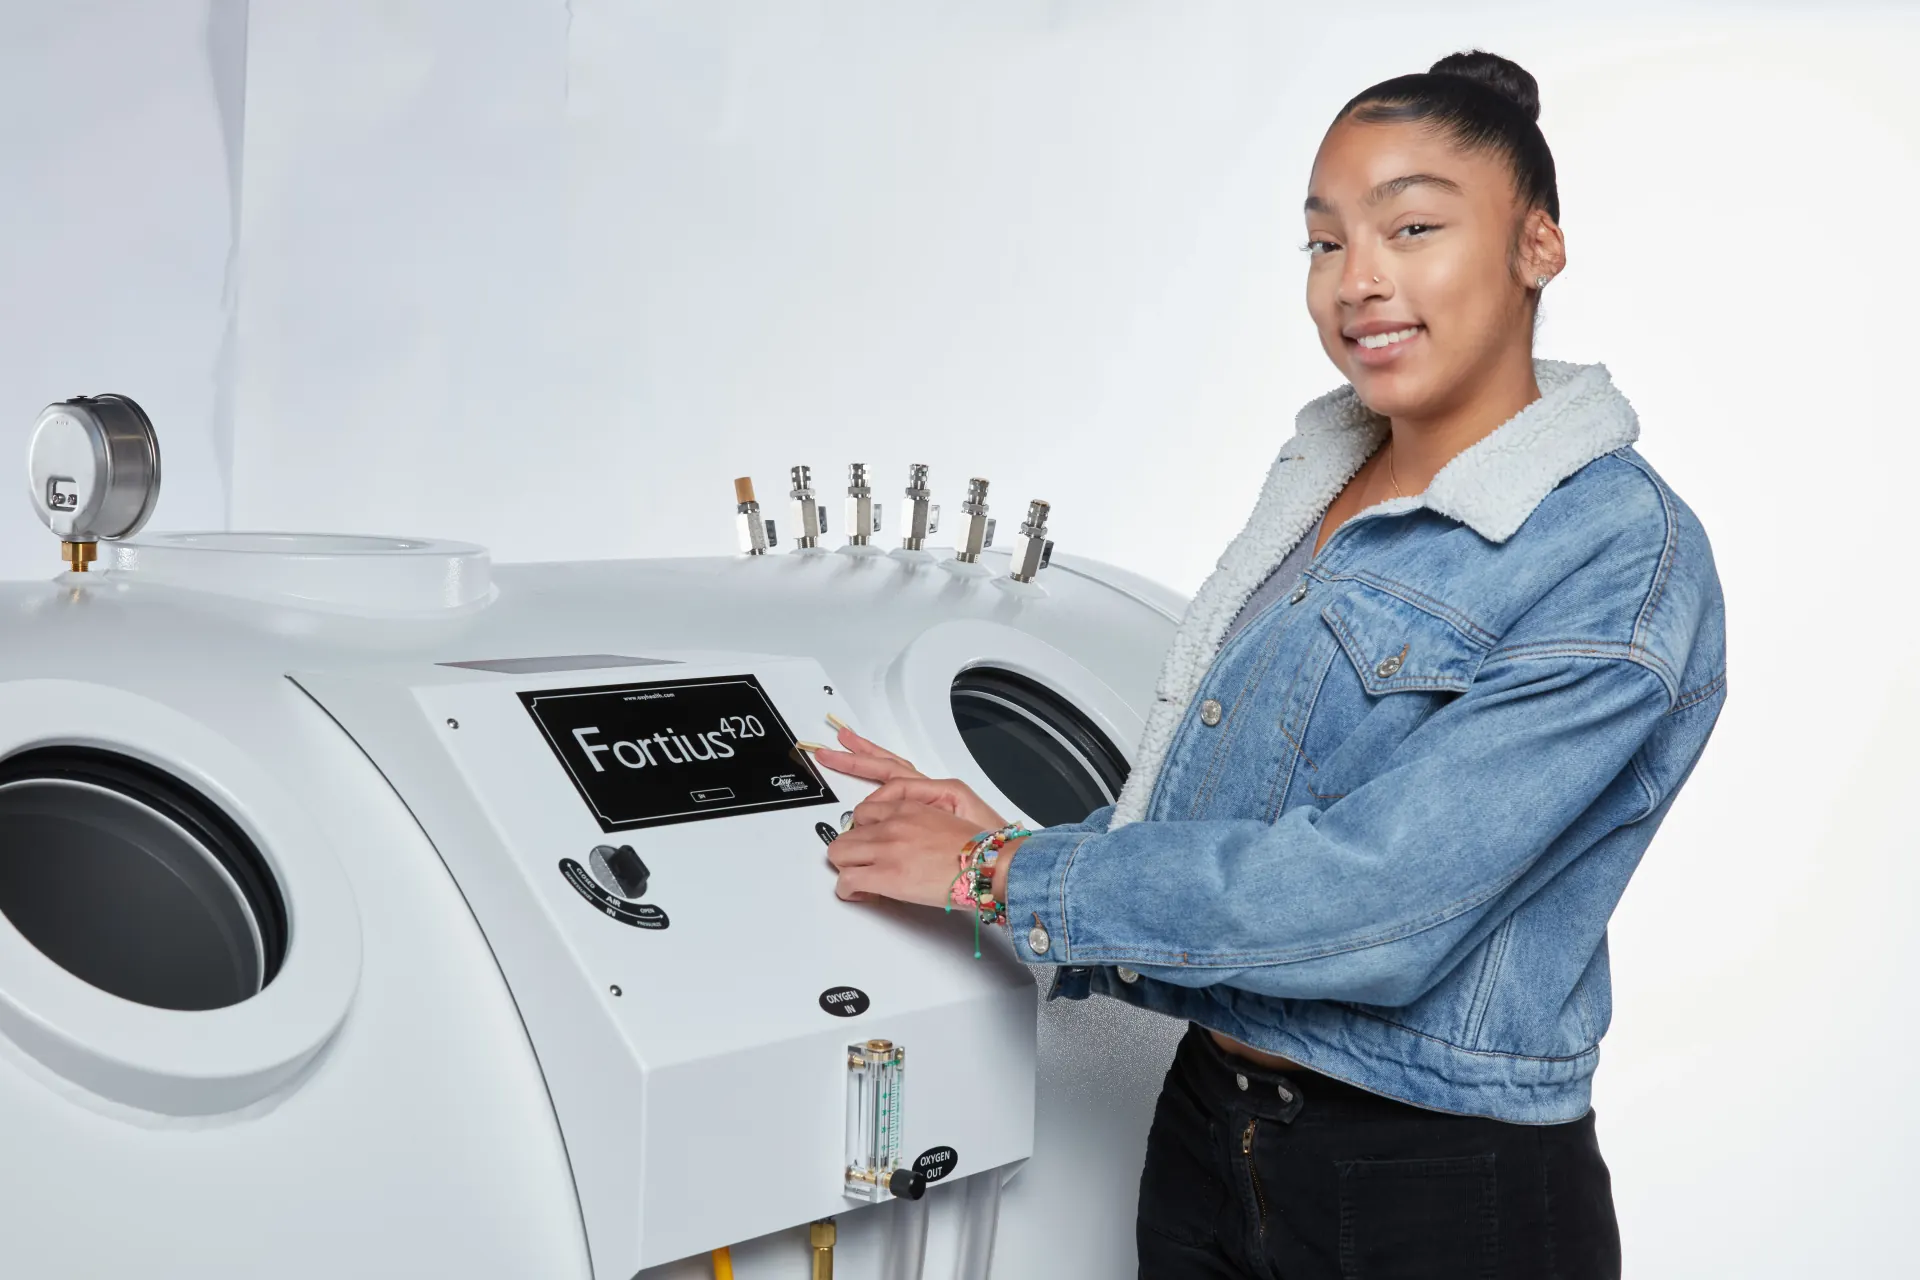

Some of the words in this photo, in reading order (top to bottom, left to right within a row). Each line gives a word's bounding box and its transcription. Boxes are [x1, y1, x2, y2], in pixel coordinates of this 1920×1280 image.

[576, 867, 595, 889] CLOSED
[605, 895, 621, 908] AIR
[606, 906, 617, 917] IN
[826, 990, 860, 1004] OXYGEN
[844, 1004, 857, 1014] IN
[920, 1150, 951, 1167] OXYGEN
[926, 1166, 943, 1180] OUT
